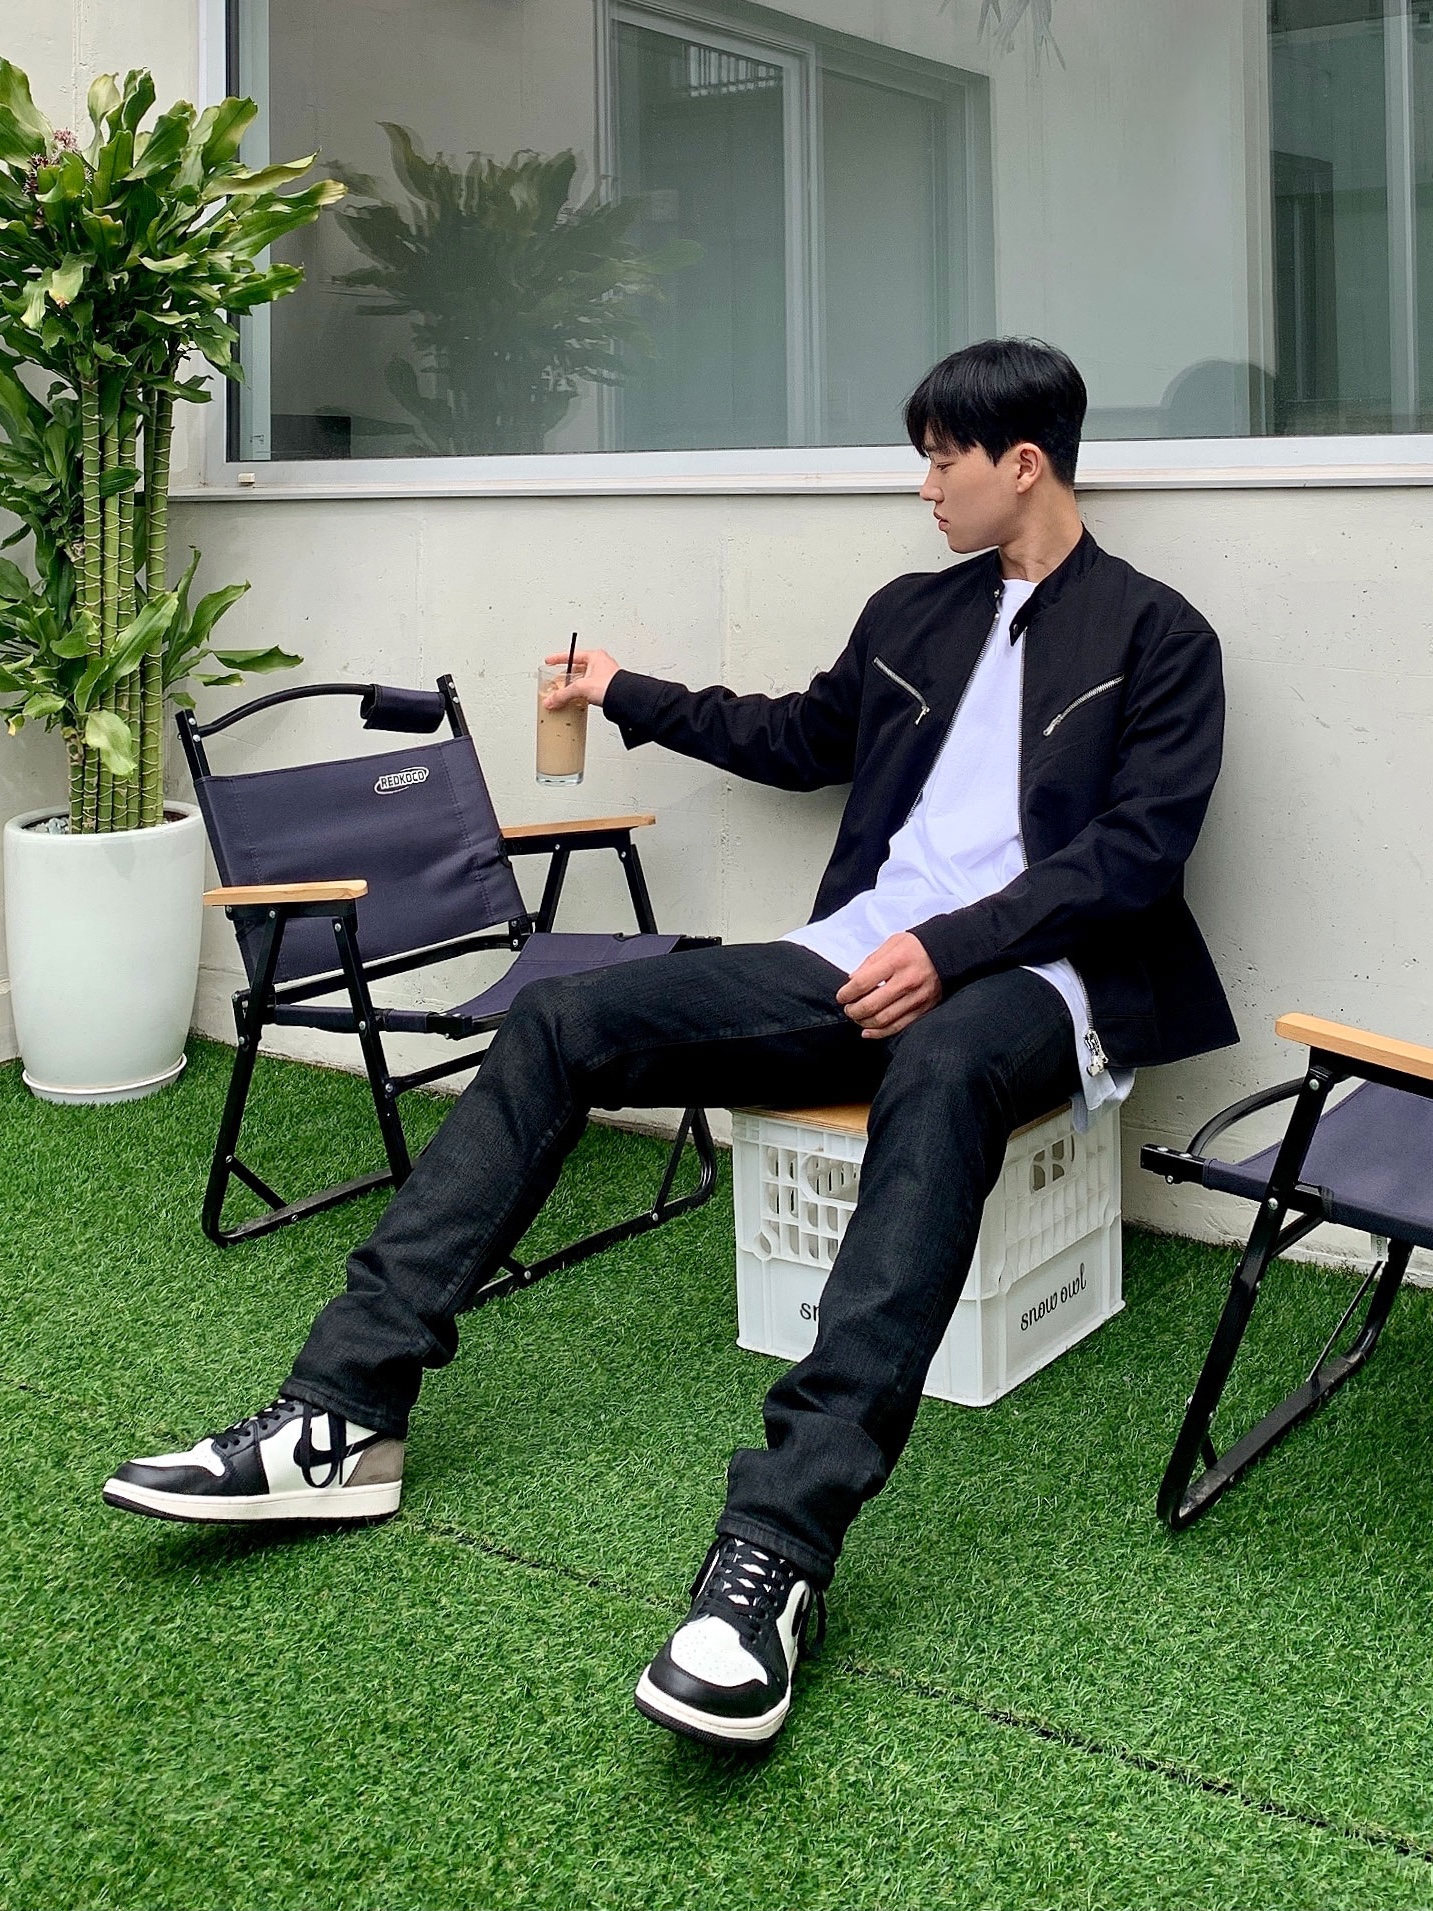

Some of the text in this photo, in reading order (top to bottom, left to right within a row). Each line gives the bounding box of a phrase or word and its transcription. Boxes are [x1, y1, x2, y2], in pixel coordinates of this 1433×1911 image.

[380, 769, 426, 789] REDKOCO
[1020, 1262, 1087, 1331] snow owl
